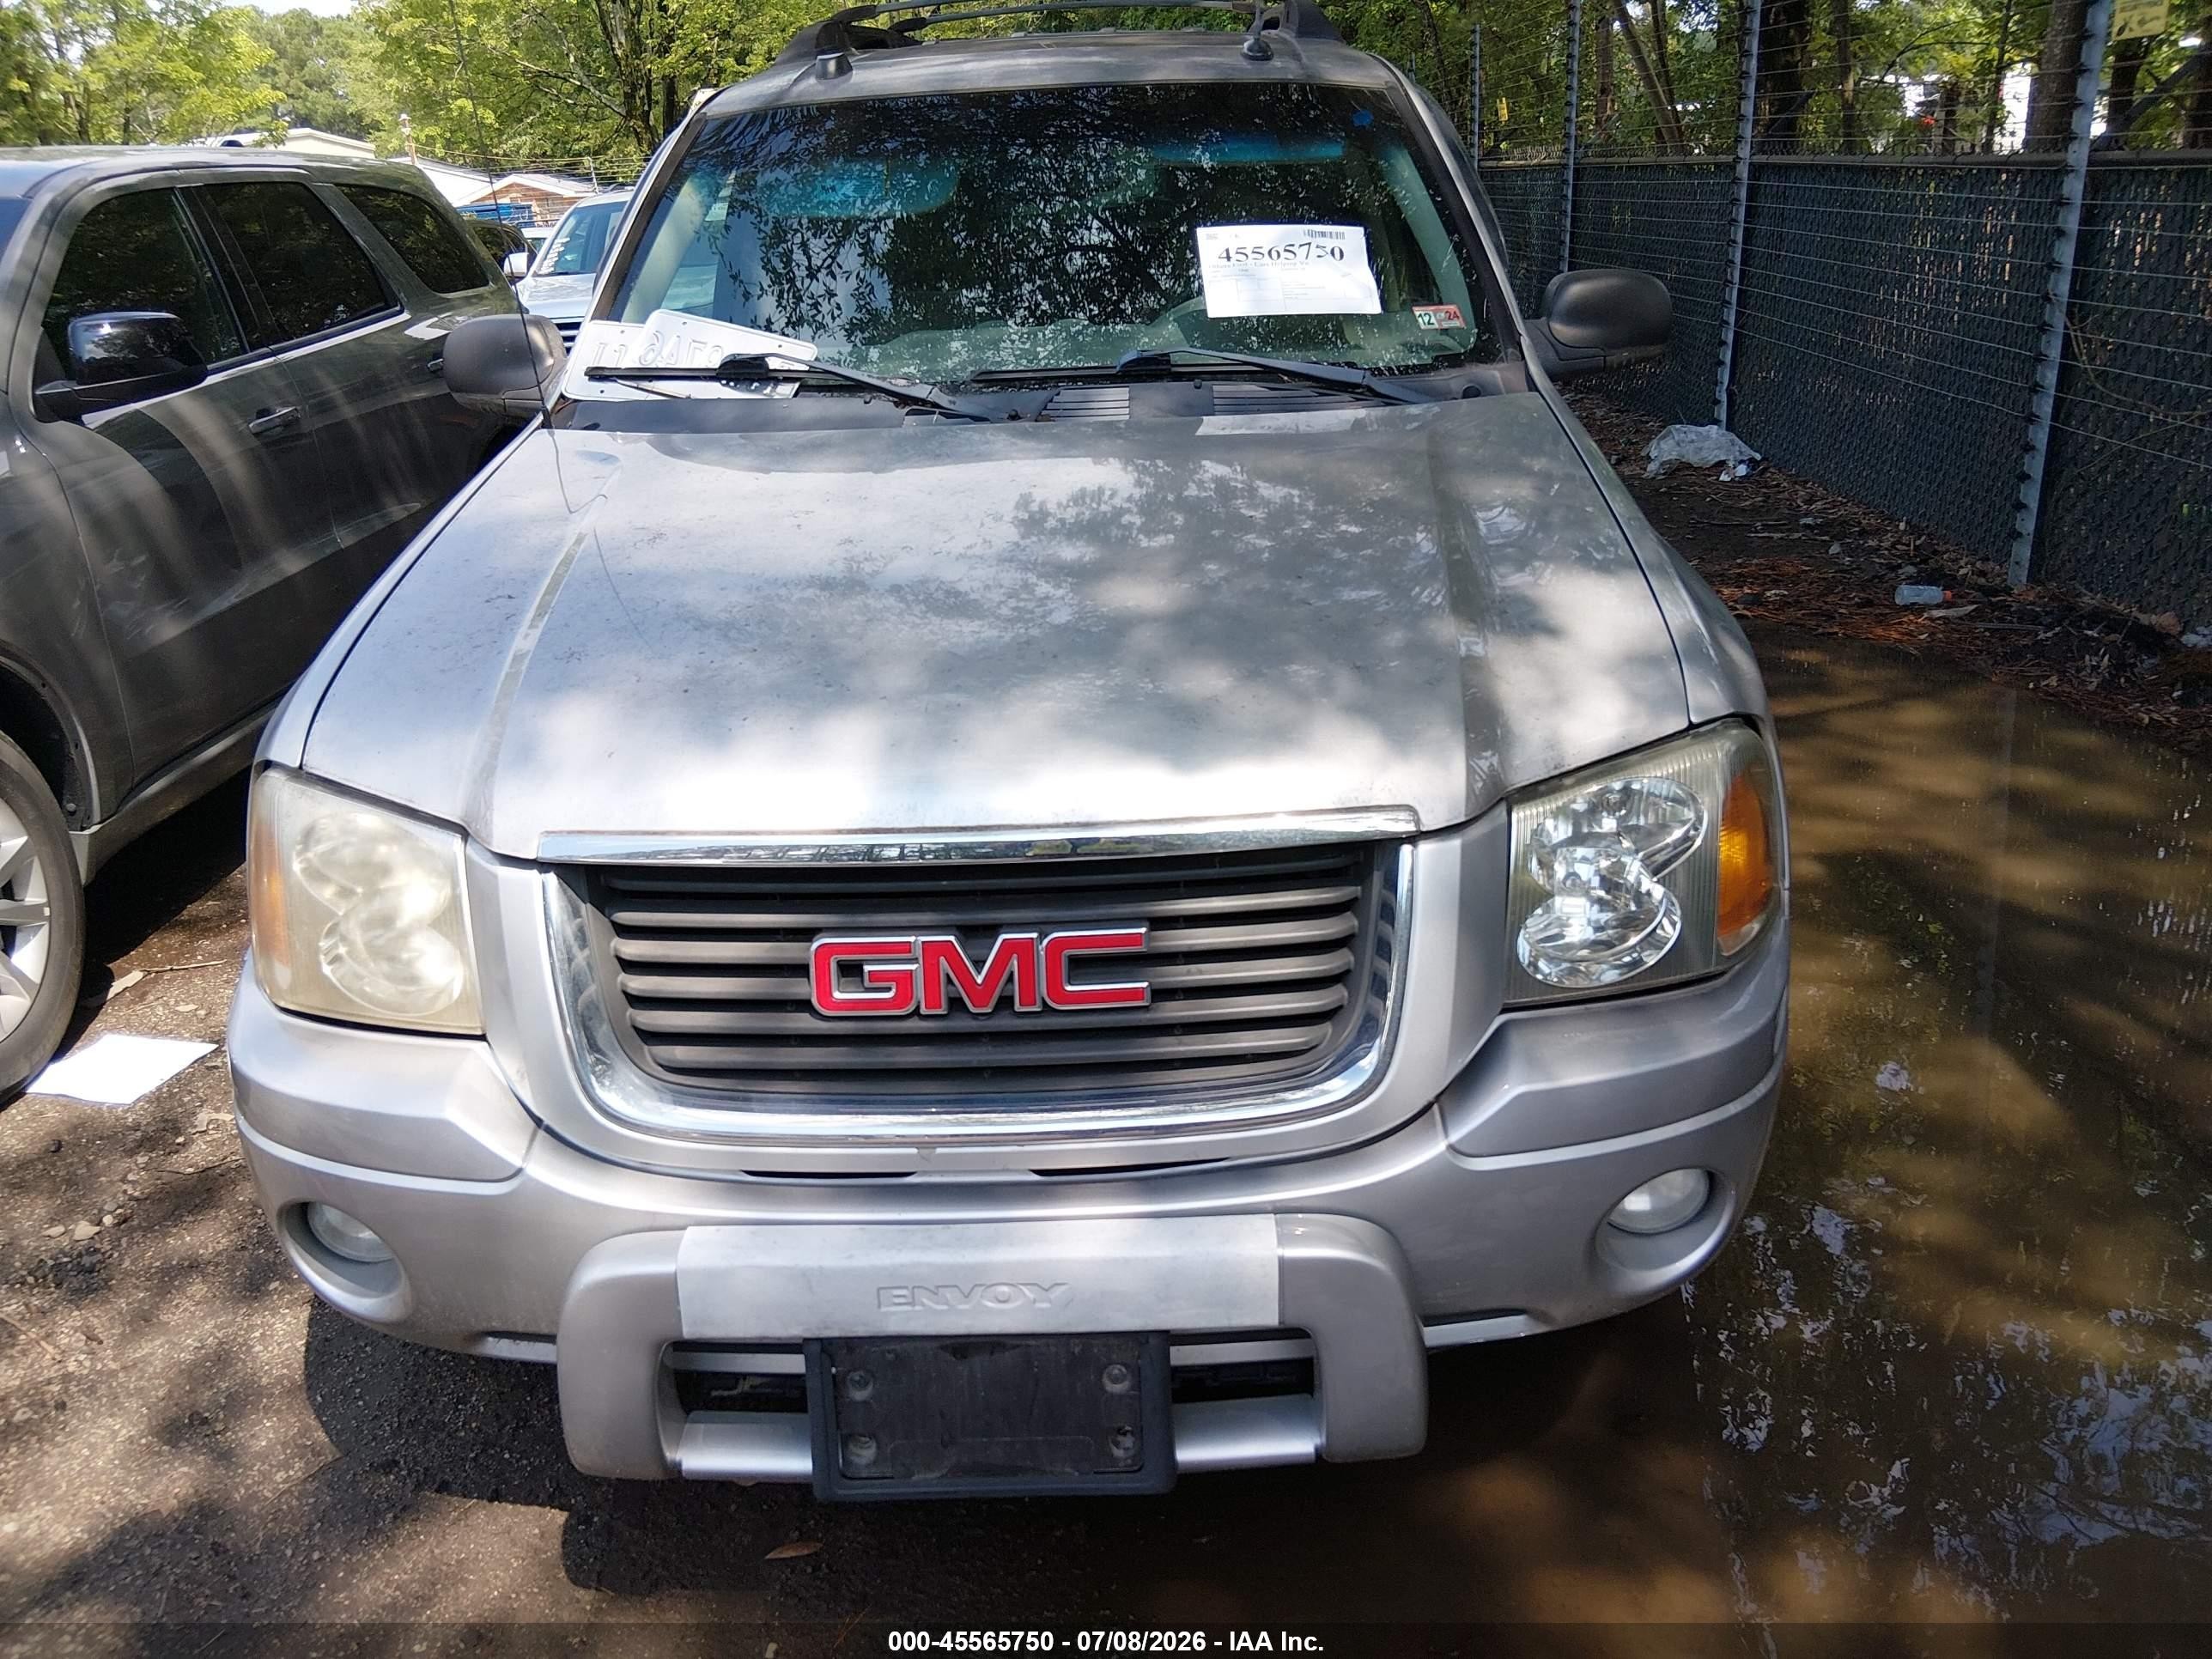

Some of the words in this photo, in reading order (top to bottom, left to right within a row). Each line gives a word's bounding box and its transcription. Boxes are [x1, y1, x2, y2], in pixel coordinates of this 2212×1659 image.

[1218, 241, 1345, 263] 45565750
[1418, 313, 1435, 325] 12
[1444, 310, 1460, 320] 24
[811, 927, 1150, 1016] GMC
[877, 1282, 1073, 1311] ENVOY
